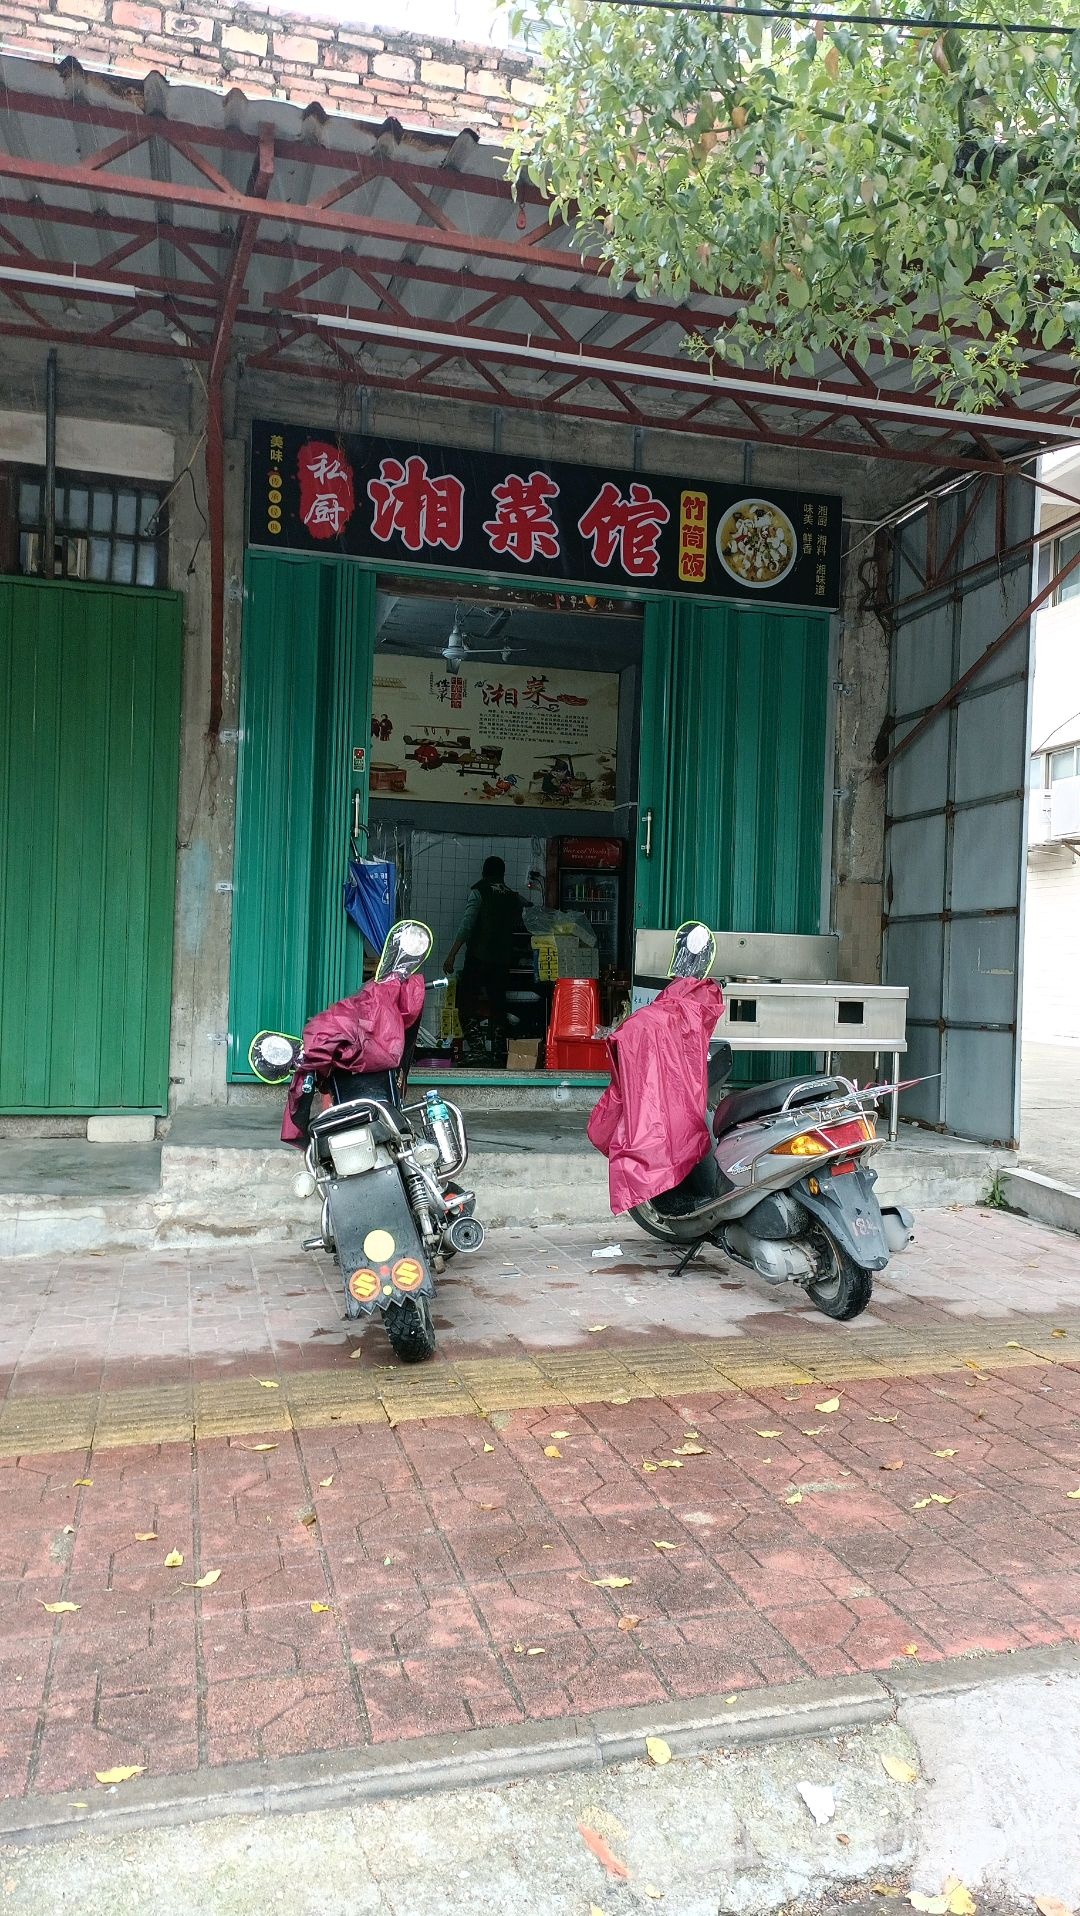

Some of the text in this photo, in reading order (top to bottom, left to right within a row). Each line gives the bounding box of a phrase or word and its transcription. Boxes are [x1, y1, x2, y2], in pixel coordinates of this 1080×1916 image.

[303, 452, 348, 532] 私厨
[367, 455, 671, 576] 湘菜馆
[681, 495, 706, 577] 竹筒饭
[481, 674, 559, 708] 湘菜
